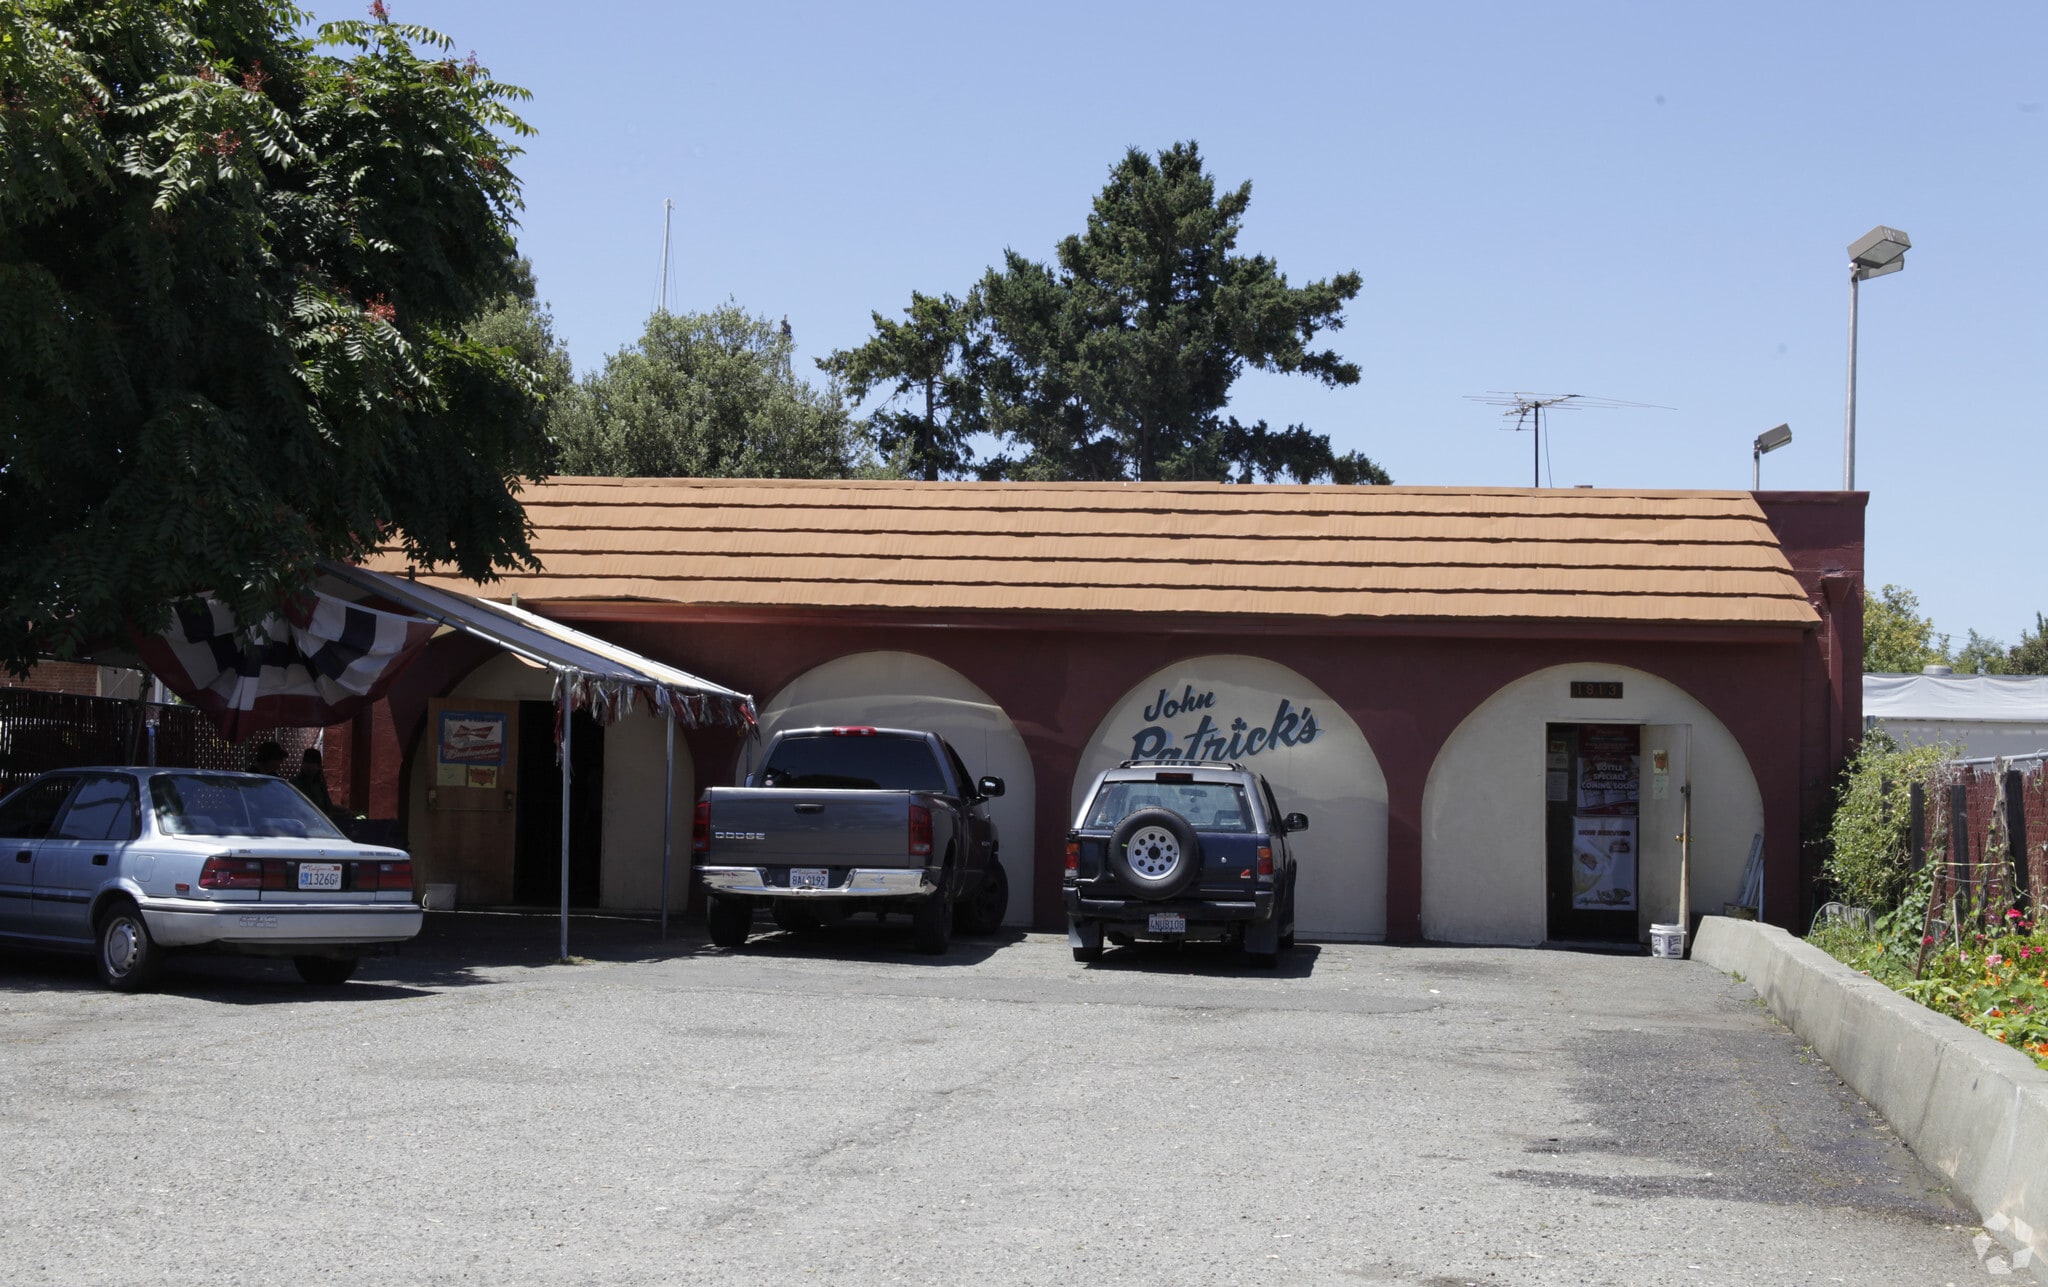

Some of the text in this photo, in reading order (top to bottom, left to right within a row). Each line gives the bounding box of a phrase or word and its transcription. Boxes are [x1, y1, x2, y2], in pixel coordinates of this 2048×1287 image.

[1577, 684, 1617, 696] 1813
[1144, 685, 1216, 722] John
[715, 831, 765, 839] DODGE
[309, 873, 335, 886] 1326G
[1150, 919, 1184, 929] 4NUB108
